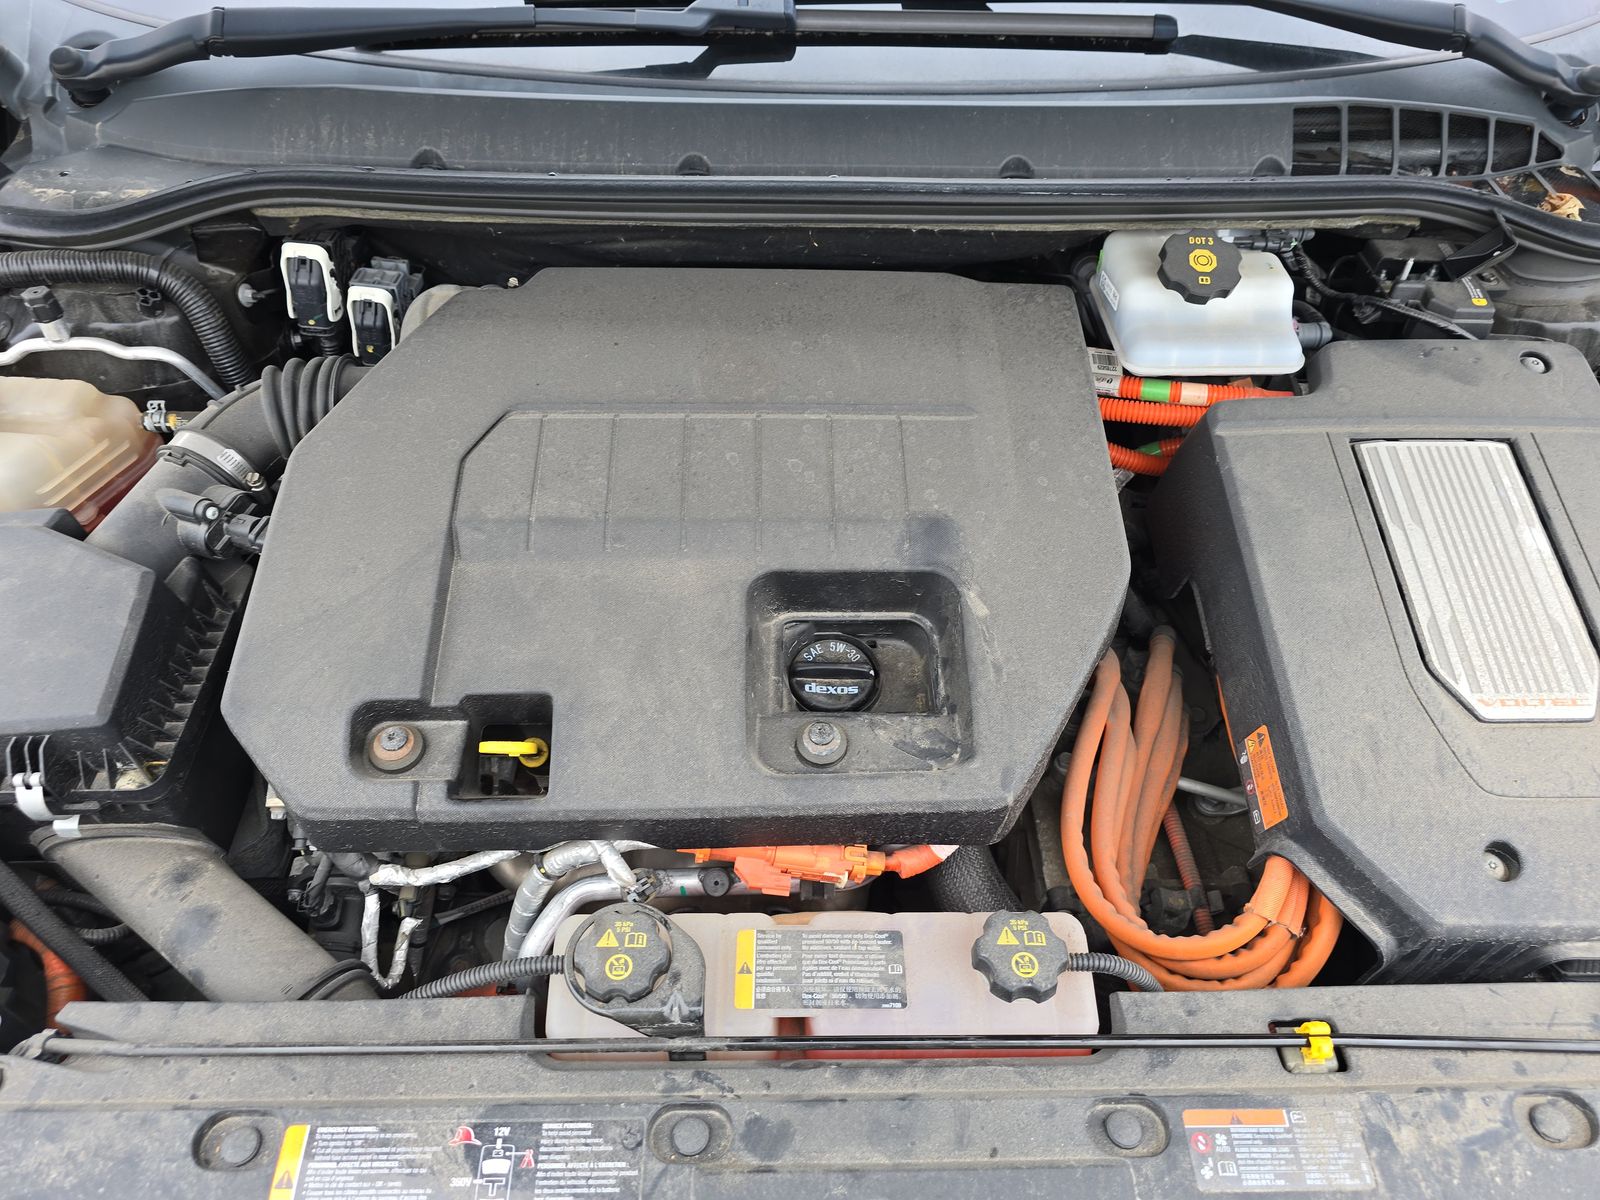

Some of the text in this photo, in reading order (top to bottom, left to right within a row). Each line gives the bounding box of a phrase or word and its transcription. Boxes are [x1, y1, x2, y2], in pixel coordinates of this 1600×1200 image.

[1188, 236, 1214, 246] DOT 3
[803, 642, 861, 662] SAE 5W-30
[804, 682, 859, 695] dexos
[494, 1126, 511, 1136] 12V
